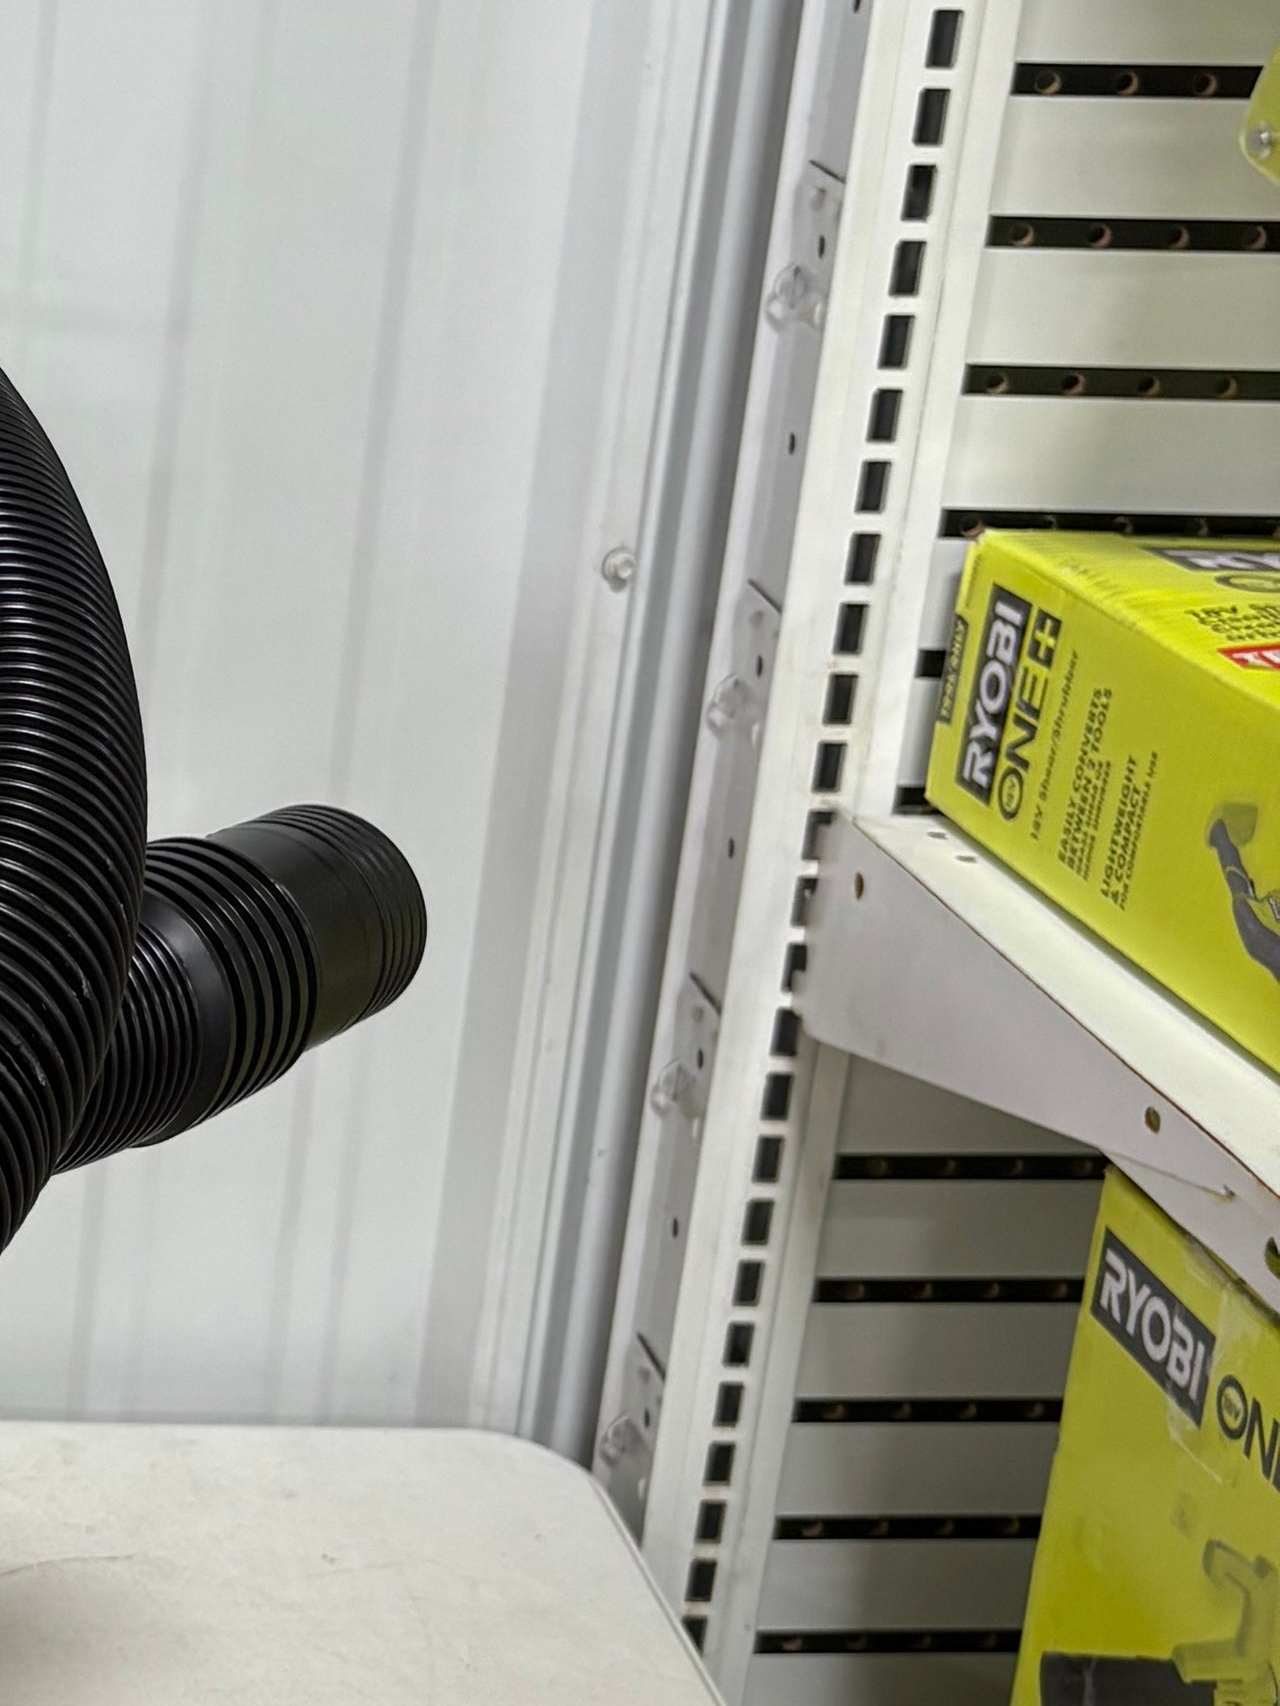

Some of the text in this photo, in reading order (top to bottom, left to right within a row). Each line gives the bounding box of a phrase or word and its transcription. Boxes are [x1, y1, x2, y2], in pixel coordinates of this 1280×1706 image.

[962, 600, 1023, 790] RYOBI
[1057, 687, 1103, 865] EASILY CONVERTS
[1066, 775, 1092, 872] BETWEEN
[1091, 687, 1113, 756] TOOLS
[1100, 753, 1138, 898] LIGHTWEIGHT
[1115, 784, 1142, 884] COMPACT
[1099, 1246, 1206, 1400] RYOBI
[1217, 1374, 1280, 1493] ON
